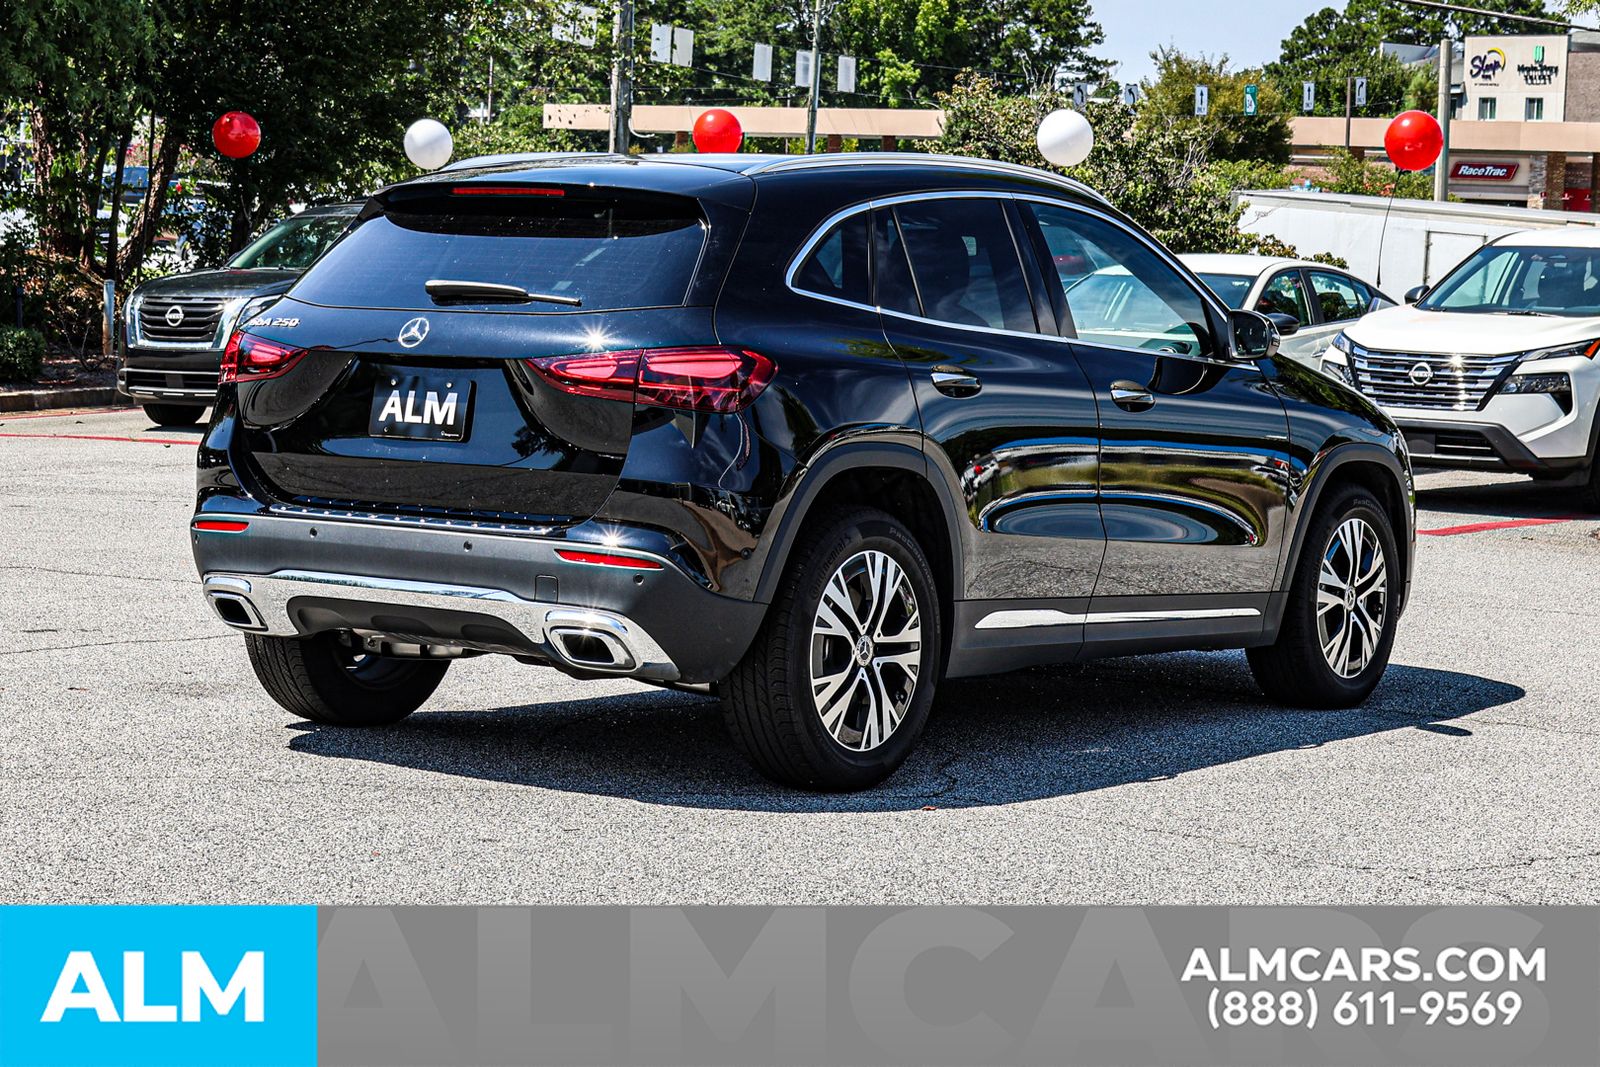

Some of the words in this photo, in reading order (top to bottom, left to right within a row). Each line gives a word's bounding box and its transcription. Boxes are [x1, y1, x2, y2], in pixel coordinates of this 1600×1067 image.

[1458, 165, 1507, 177] RaceTrac
[272, 317, 300, 328] 250
[378, 390, 458, 425] ALM
